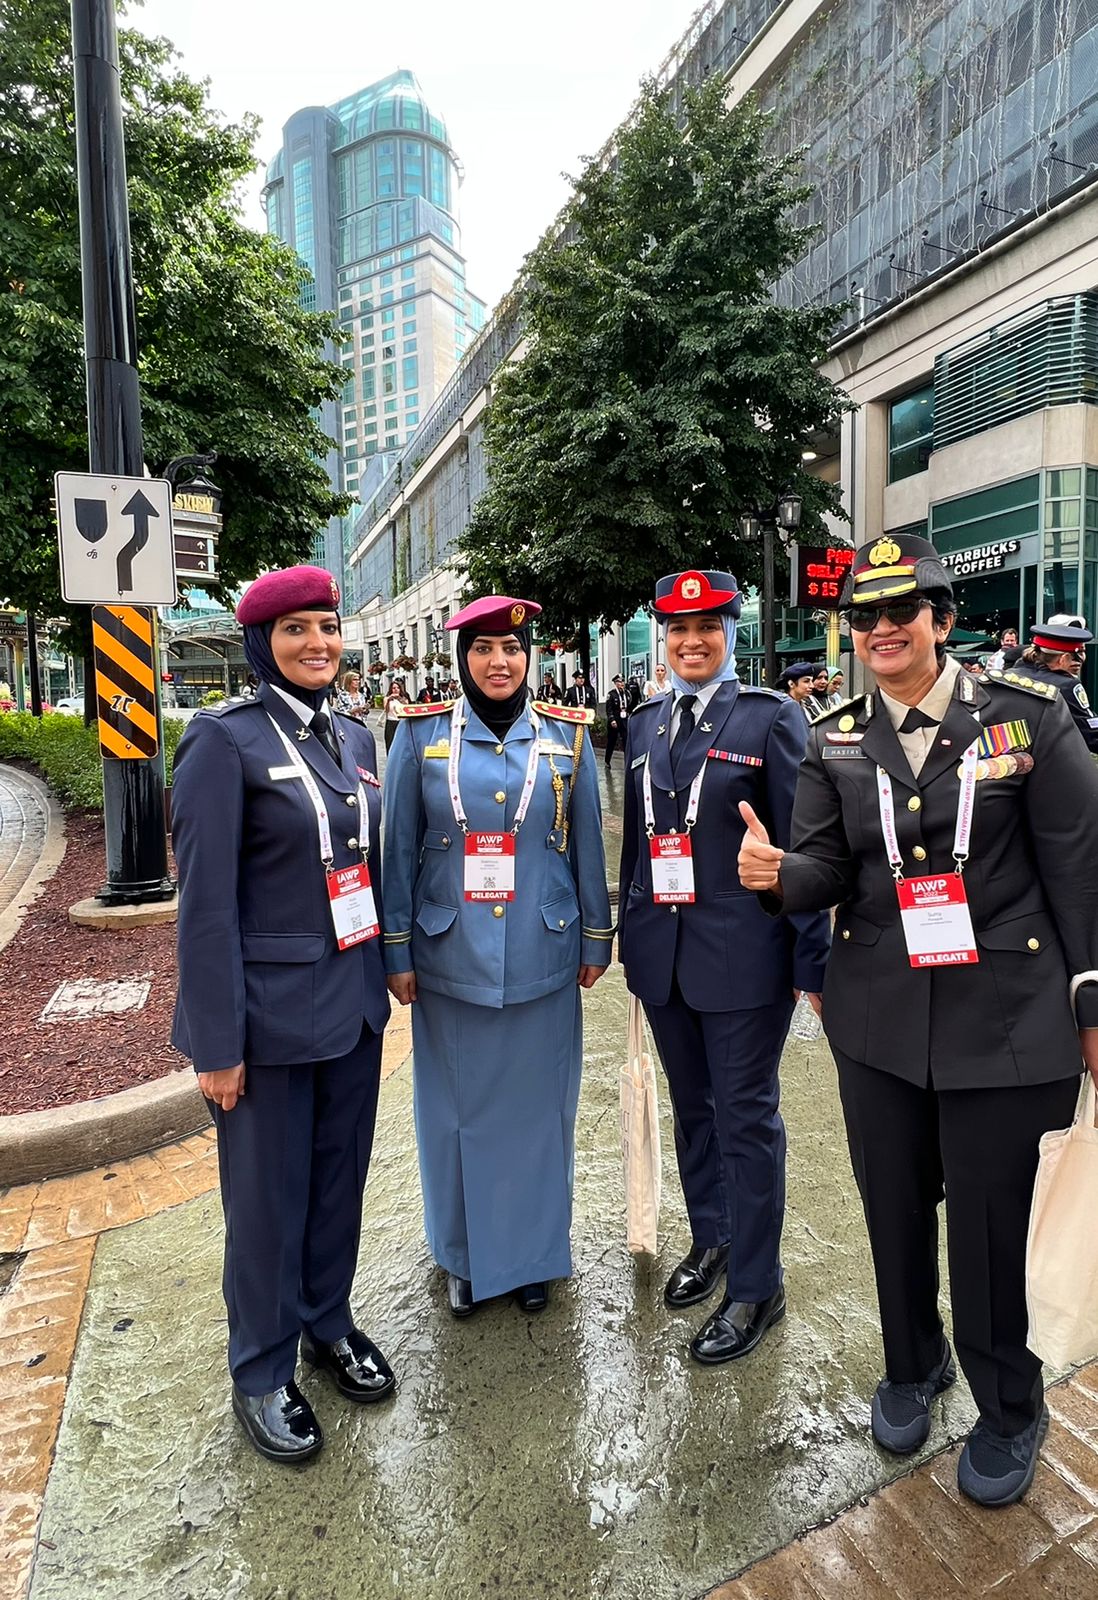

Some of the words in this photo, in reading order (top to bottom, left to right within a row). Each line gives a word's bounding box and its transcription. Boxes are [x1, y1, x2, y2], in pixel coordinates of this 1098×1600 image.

[941, 540, 1017, 567] STARBUCKS
[807, 564, 845, 579] SELF
[954, 556, 1002, 576] COFFEE
[961, 801, 970, 829] NIAGARA
[476, 835, 503, 844] IAWP
[658, 837, 681, 847] IAWP
[959, 829, 967, 847] FALLS
[336, 868, 360, 884] IAWP
[911, 879, 947, 893] IAWP
[343, 926, 375, 945] DELEGATE
[918, 952, 969, 964] DELEGATE
